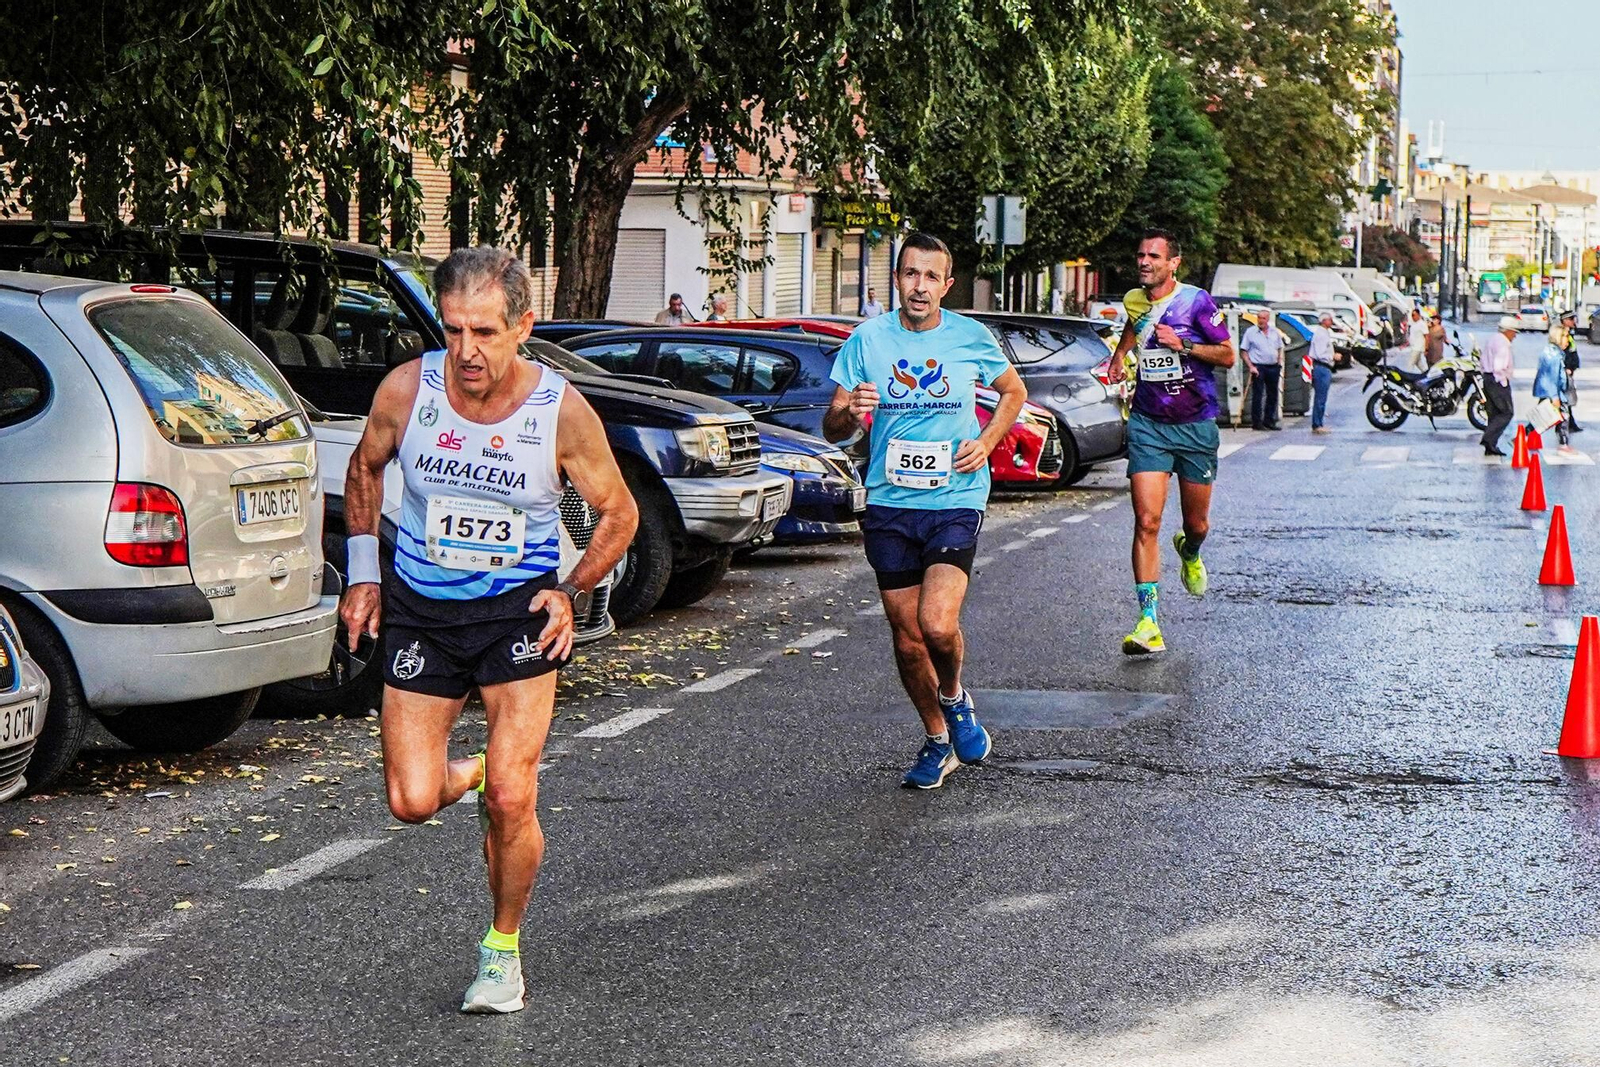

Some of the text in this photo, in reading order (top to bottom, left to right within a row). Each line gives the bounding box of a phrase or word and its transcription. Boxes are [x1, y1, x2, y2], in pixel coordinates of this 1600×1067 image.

[1142, 356, 1174, 368] 1529
[878, 402, 962, 410] CARRERA-MARCHA
[415, 454, 526, 489] MARACENA
[900, 454, 936, 469] 562
[423, 476, 446, 484] CLUB
[461, 482, 511, 496] ATLETISMO
[250, 488, 298, 518] 7406 CFC
[440, 514, 511, 542] 1573
